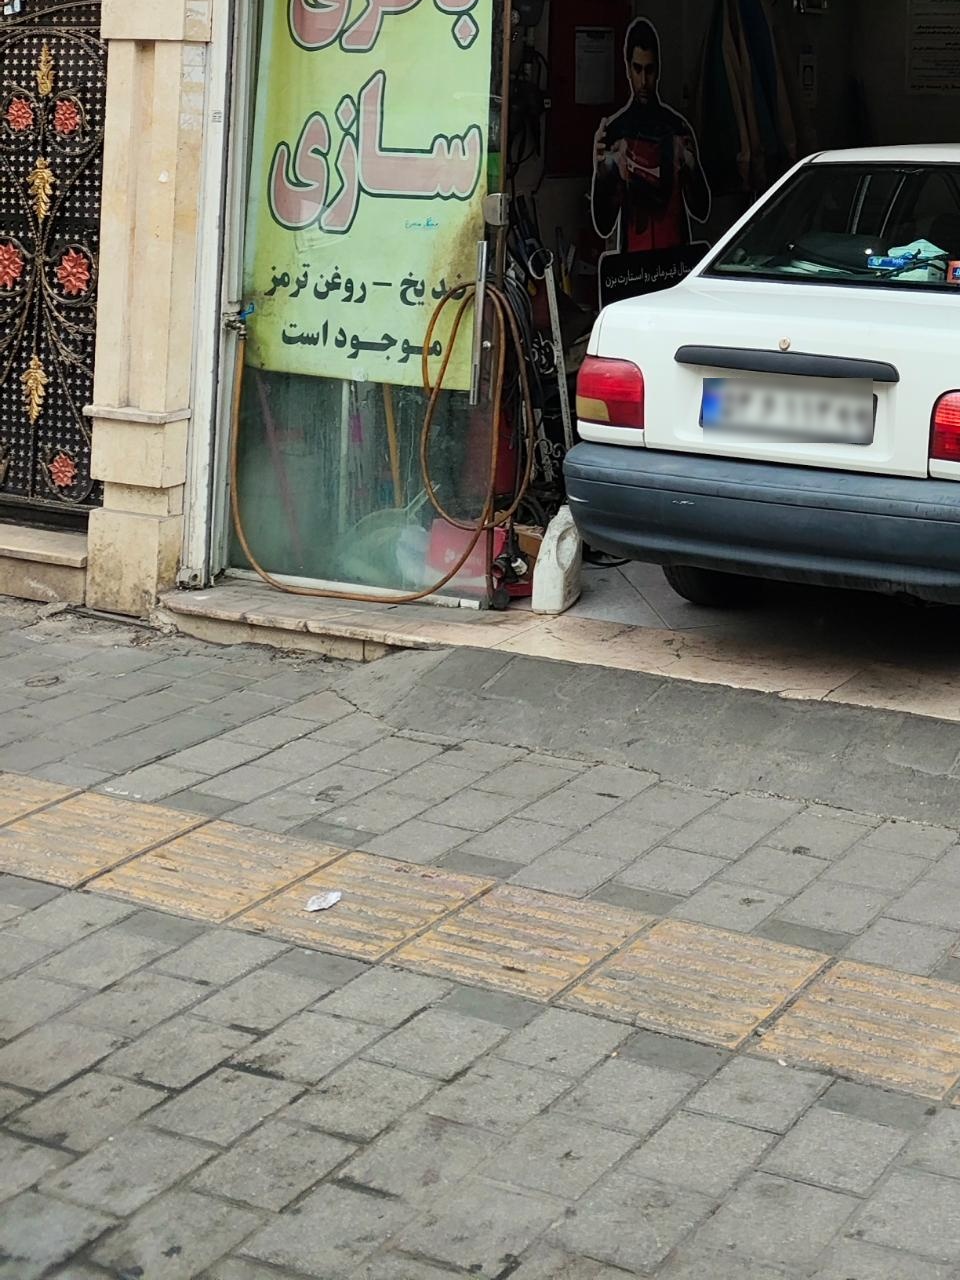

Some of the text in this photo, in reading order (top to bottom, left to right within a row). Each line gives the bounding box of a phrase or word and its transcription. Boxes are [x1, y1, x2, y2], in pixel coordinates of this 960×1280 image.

[267, 69, 482, 234] سازی
[264, 263, 311, 298] ترمز
[313, 265, 367, 303] روغن
[400, 272, 425, 306] یخ
[281, 319, 442, 363] موجود است
